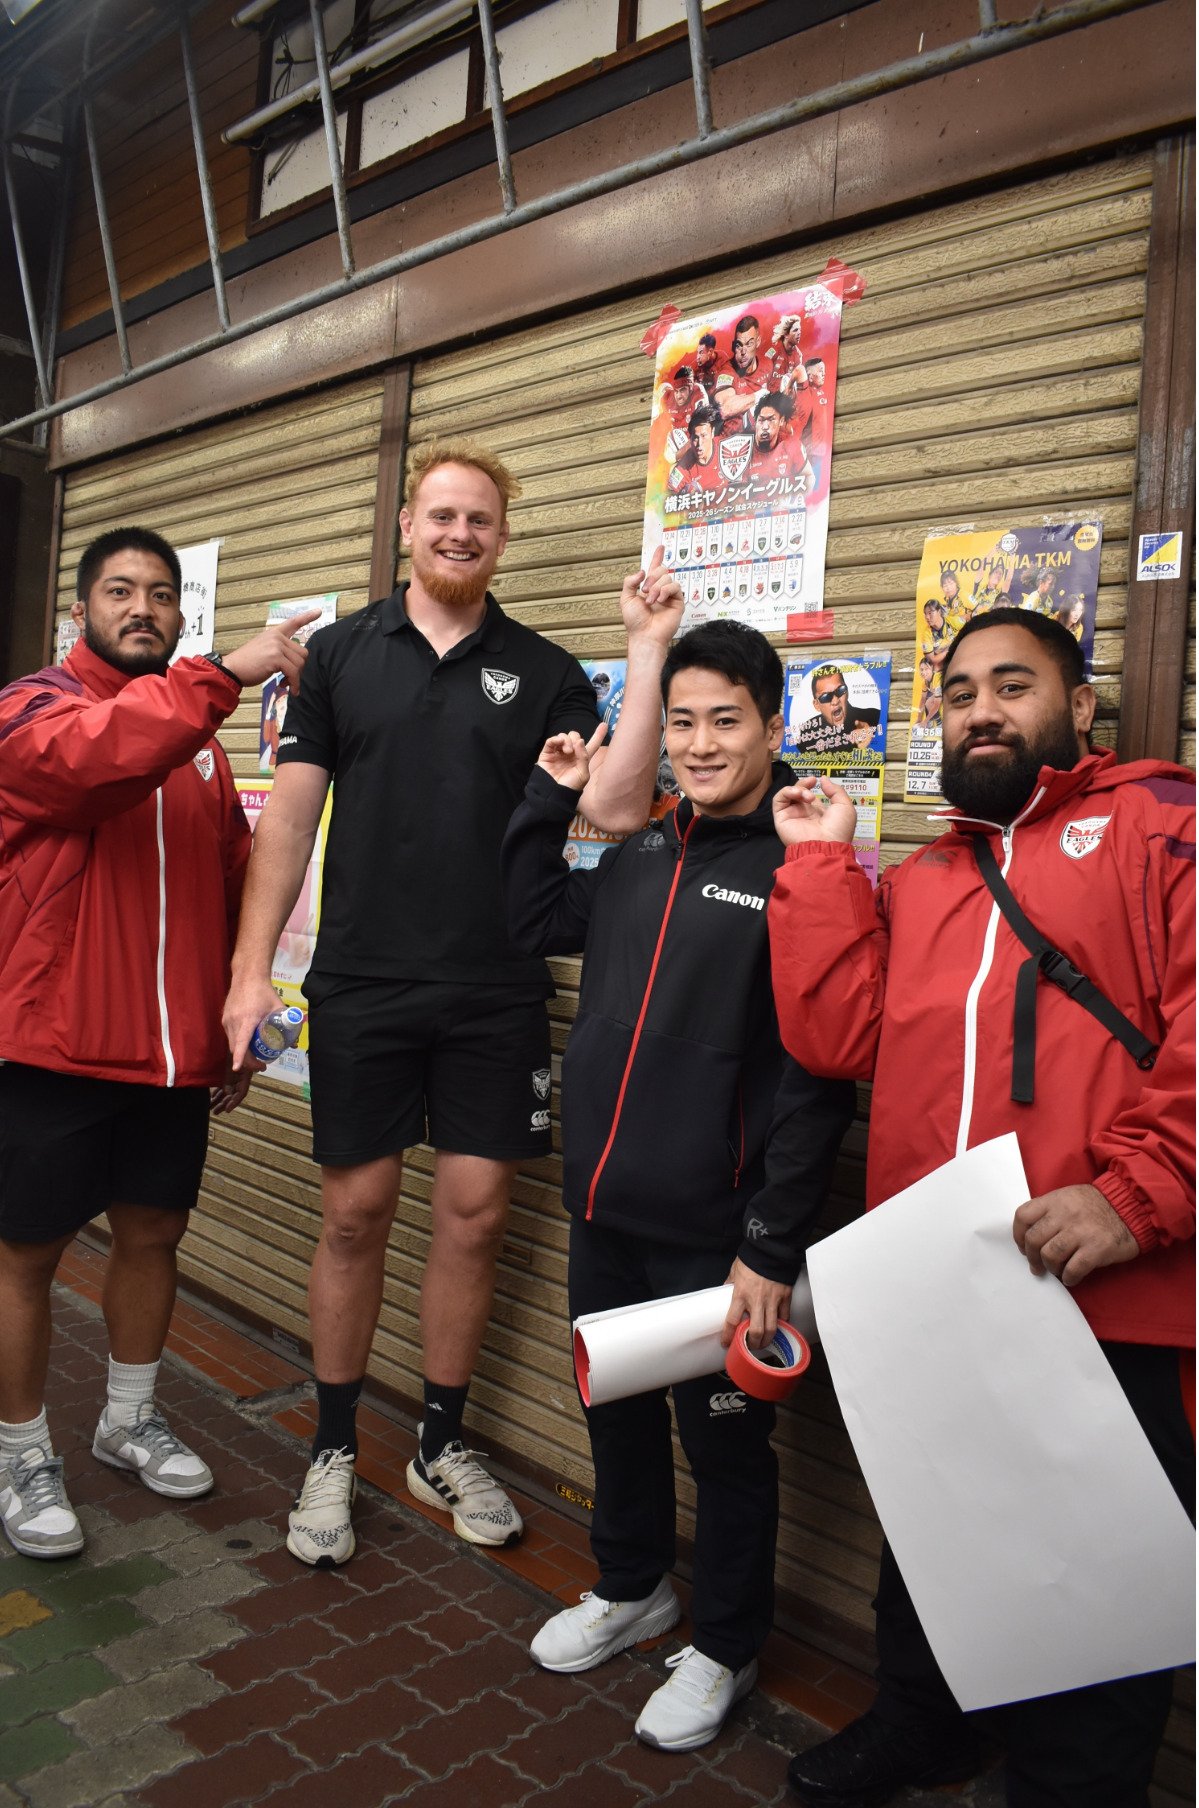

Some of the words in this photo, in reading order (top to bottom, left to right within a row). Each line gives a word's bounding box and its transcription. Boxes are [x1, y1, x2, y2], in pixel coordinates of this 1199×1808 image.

[723, 456, 747, 465] EAGLES
[664, 475, 806, 513] 横浜キヤノンイーグルス
[939, 554, 1031, 574] YOKOHAMA
[1035, 550, 1072, 568] TKM
[1141, 564, 1176, 573] ALSOK
[909, 751, 931, 760] 10.26
[1066, 835, 1102, 843] EAGLES
[702, 884, 765, 910] Canon
[709, 1407, 747, 1417] canterbury
